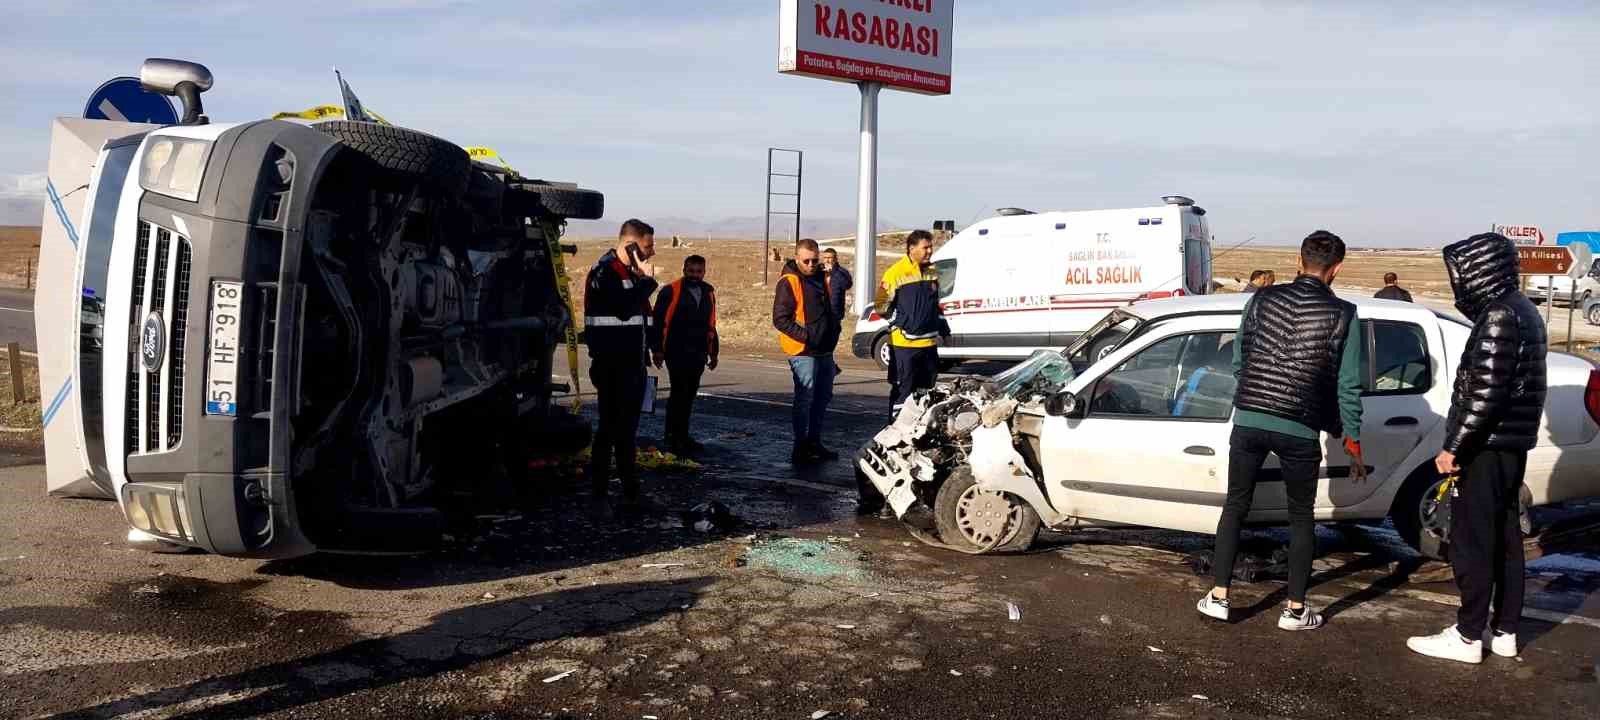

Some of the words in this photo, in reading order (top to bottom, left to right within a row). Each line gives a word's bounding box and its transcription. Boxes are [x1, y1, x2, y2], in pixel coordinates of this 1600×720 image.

[815, 4, 939, 57] KASABASI
[1096, 264, 1143, 285] SAĞLIK
[144, 327, 156, 359] Ford
[213, 379, 233, 402] 51
